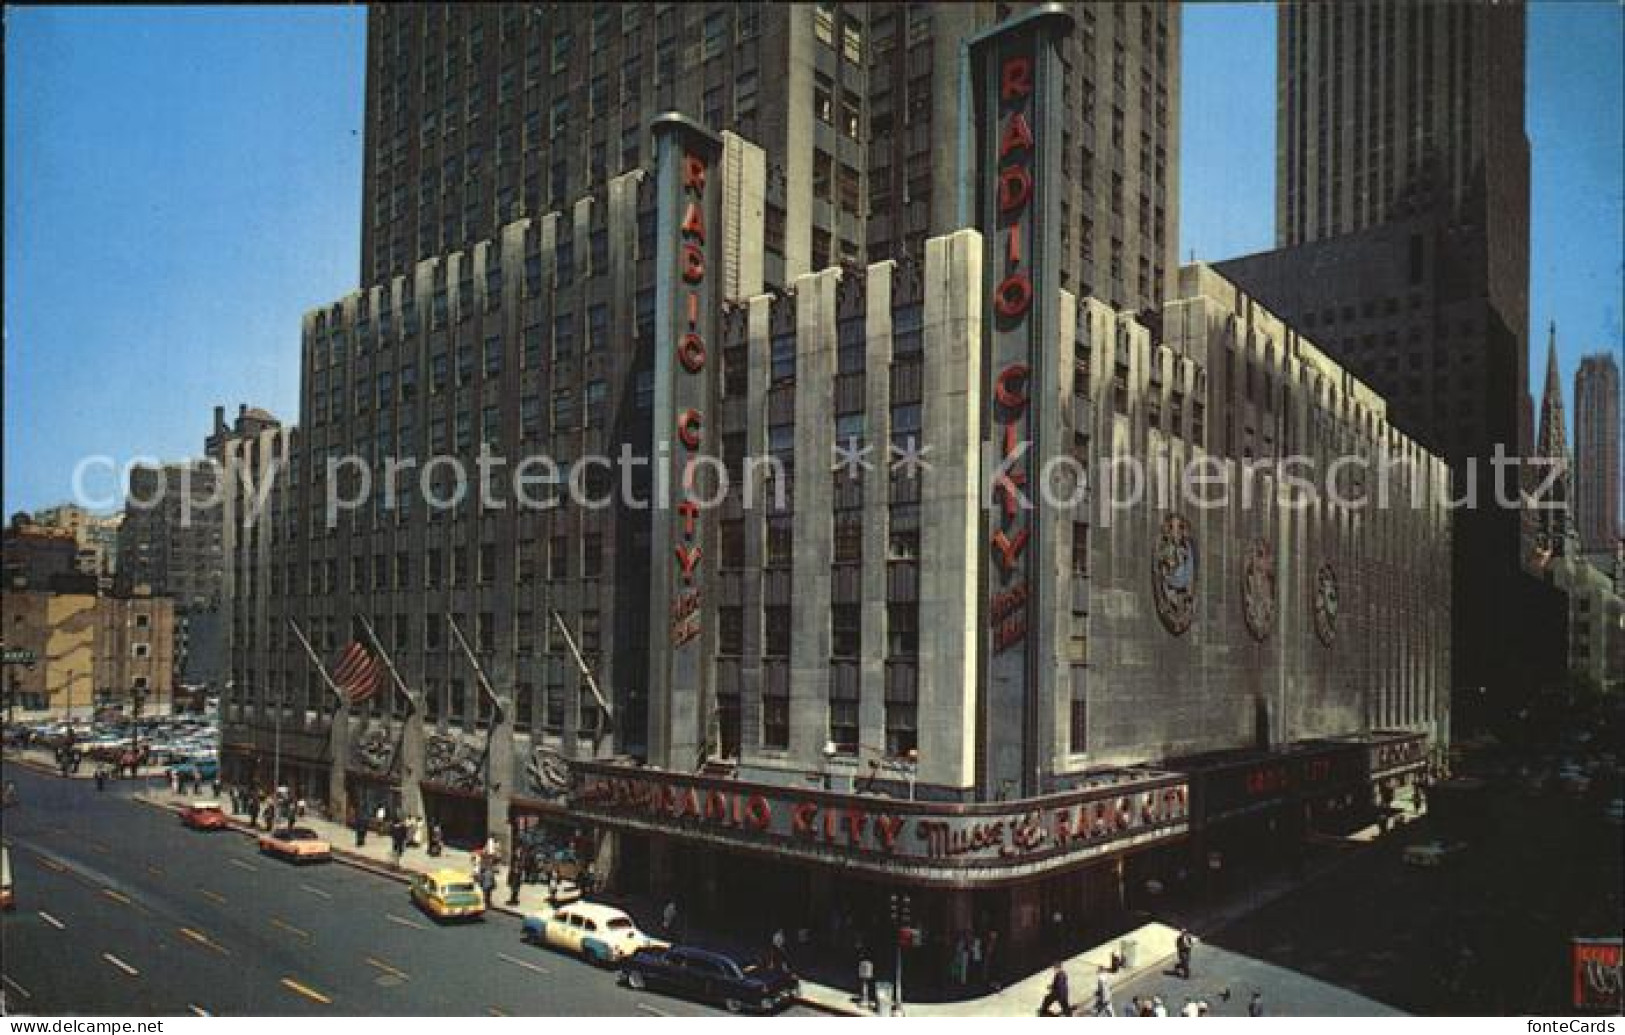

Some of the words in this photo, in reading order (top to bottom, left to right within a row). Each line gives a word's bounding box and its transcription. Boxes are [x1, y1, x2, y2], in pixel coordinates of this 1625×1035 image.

[677, 150, 707, 374] RADIO
[994, 55, 1036, 322] RADIO
[673, 407, 703, 584] CITY
[990, 363, 1034, 571] CITY
[792, 802, 906, 849] CITY
